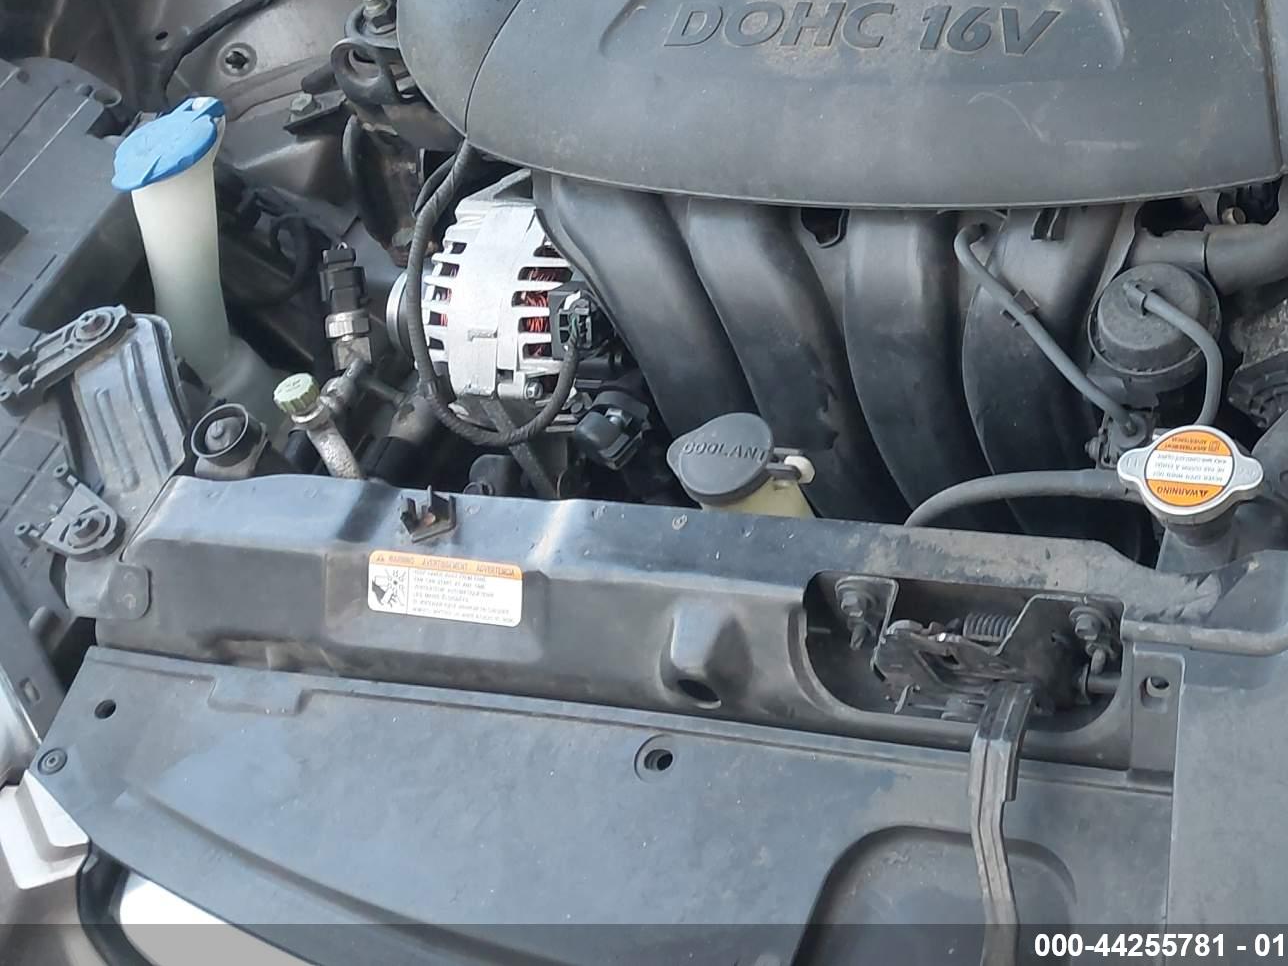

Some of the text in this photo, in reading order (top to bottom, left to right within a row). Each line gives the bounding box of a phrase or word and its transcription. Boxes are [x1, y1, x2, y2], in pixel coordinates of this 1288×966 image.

[663, 1, 1062, 57] DOHC 16V
[682, 442, 768, 462] COOLANT
[1157, 486, 1200, 498] WARNING
